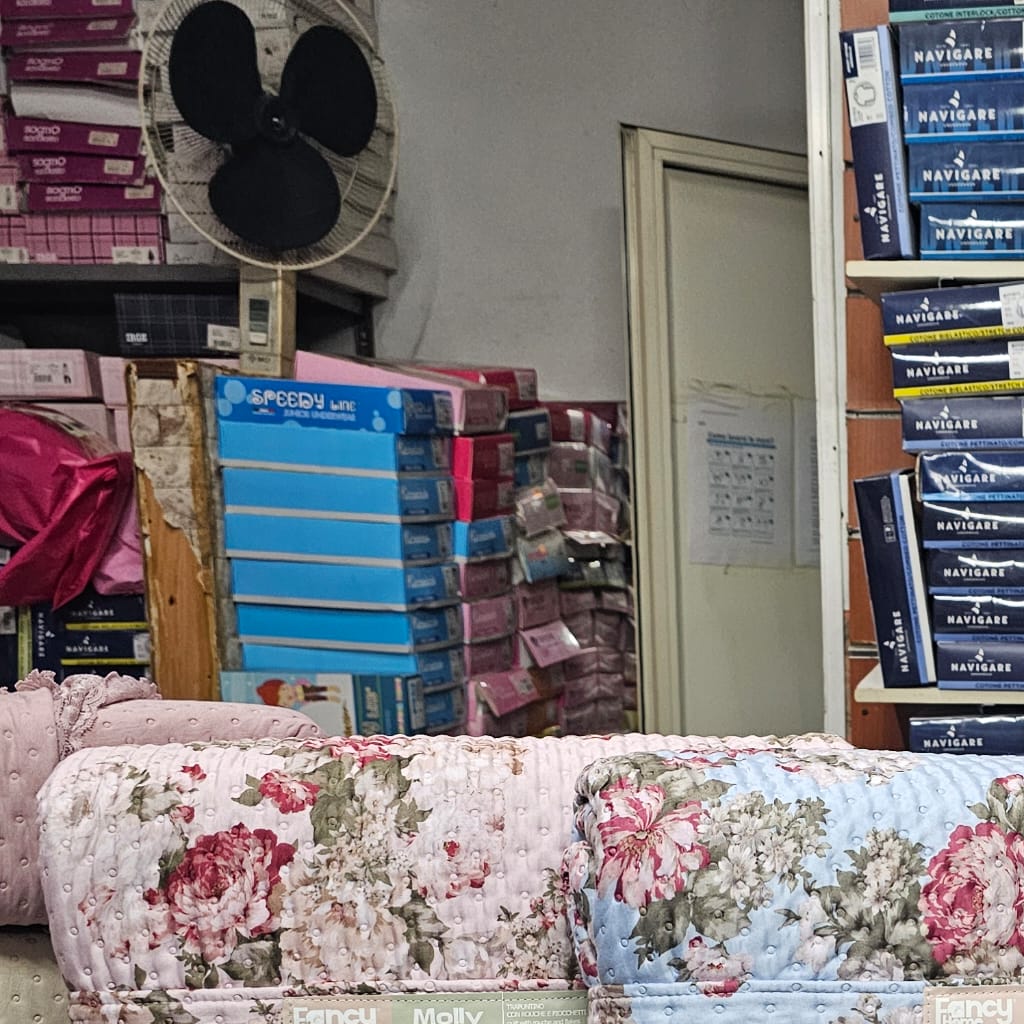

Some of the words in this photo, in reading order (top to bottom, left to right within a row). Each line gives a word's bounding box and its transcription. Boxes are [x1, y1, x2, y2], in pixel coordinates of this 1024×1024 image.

[914, 48, 993, 62] NAVIGARE
[918, 109, 996, 122] NAVIGARE
[923, 168, 1000, 181] NAVIGARE
[874, 173, 890, 243] NAVIGARE
[936, 228, 1013, 240] NAVIGARE
[896, 310, 959, 324] NAVIGARE
[906, 365, 969, 377] NAVIGARE
[252, 389, 325, 410] SPEEDY
[915, 420, 978, 430] NAVIGARE
[937, 521, 998, 530] NAVIGARE
[944, 568, 1005, 577] NAVIGARE
[948, 616, 1008, 625] NAVIGARE
[893, 611, 910, 672] NAVIGARE
[951, 663, 1012, 672] NAVIGARE
[924, 738, 983, 748] NAVIGARE
